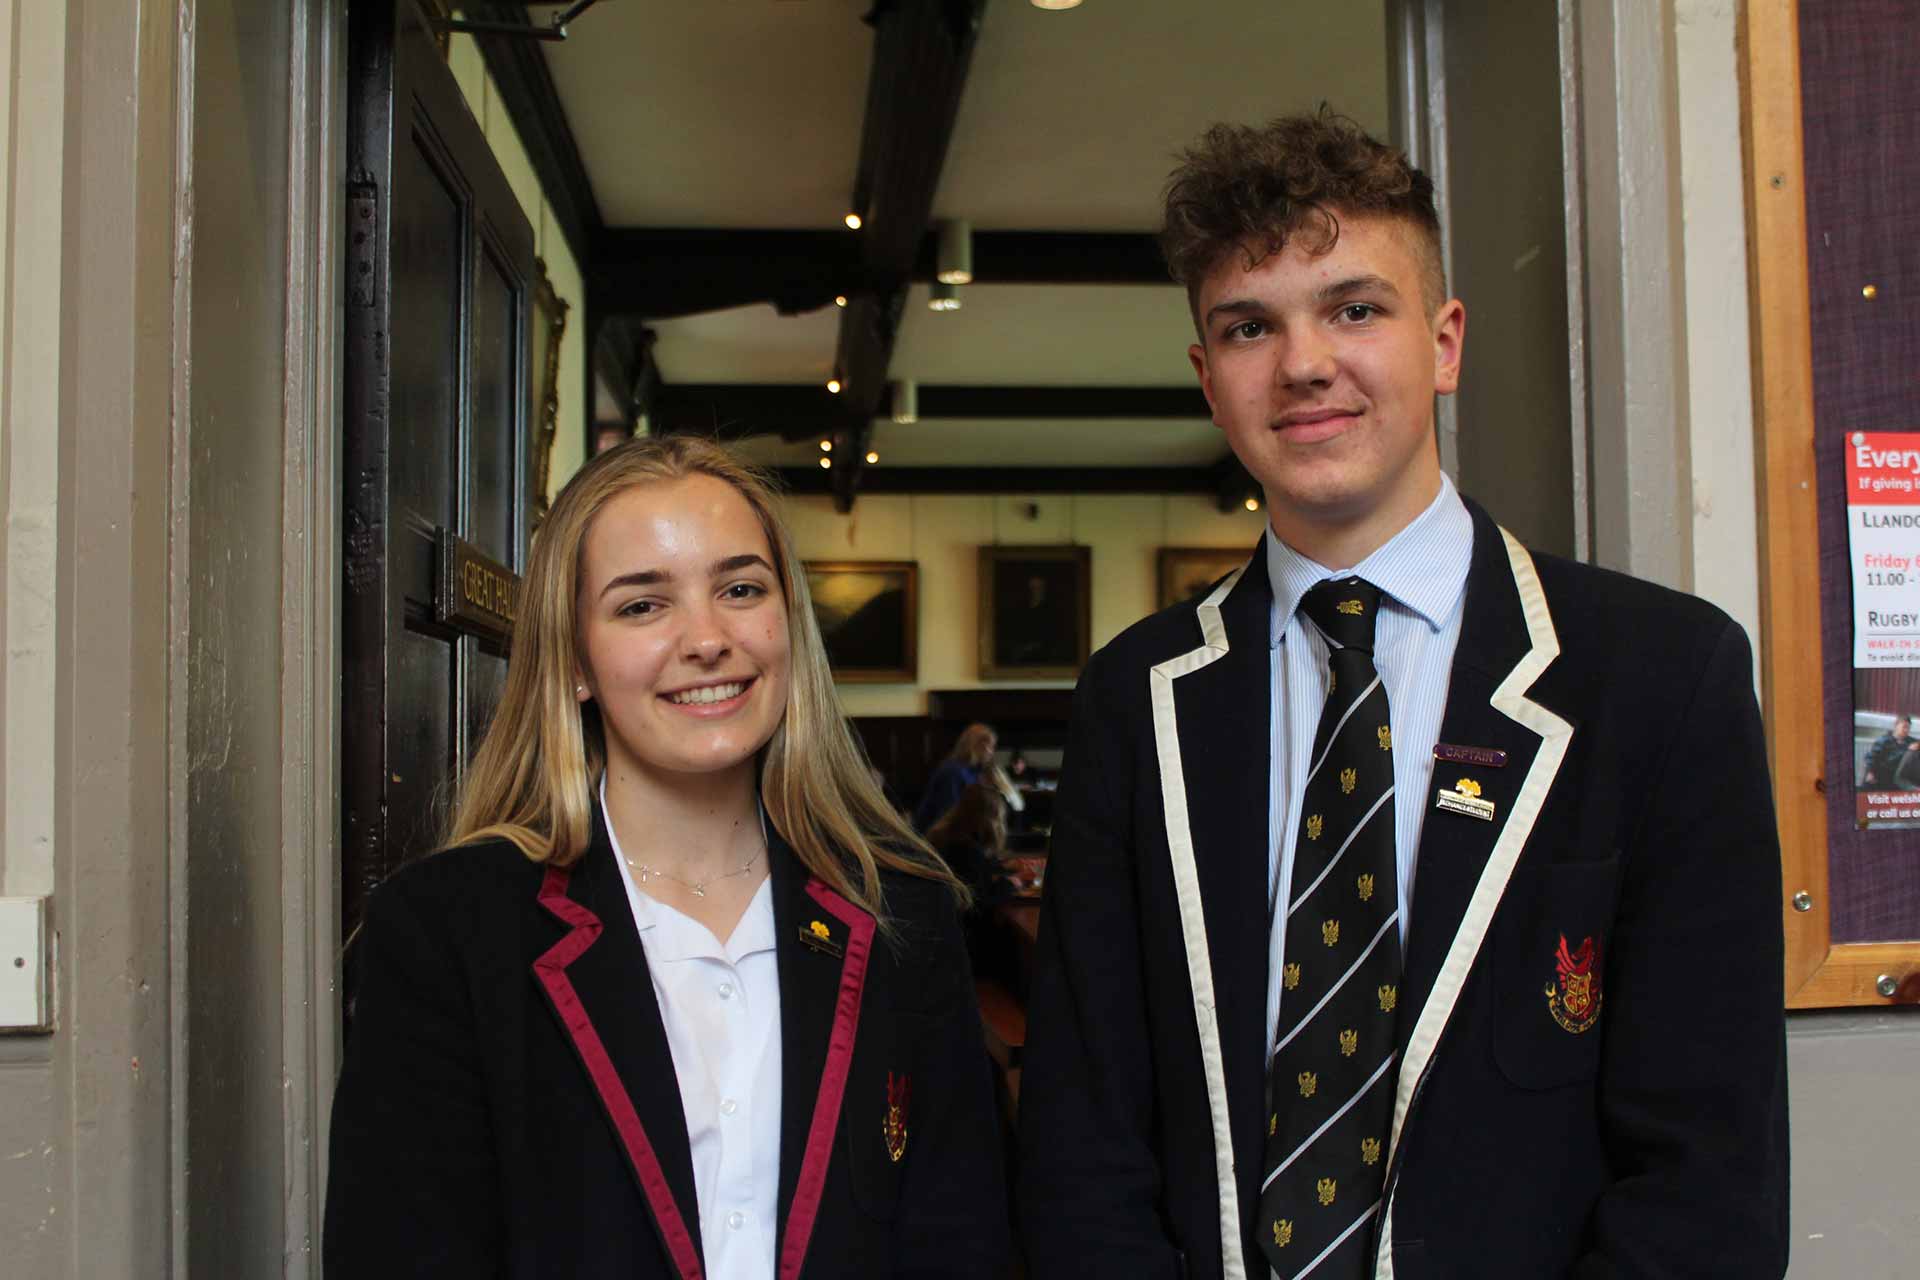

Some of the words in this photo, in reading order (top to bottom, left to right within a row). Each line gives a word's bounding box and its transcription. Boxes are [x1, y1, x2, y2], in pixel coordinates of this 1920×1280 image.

[1859, 477, 1870, 489] If
[1872, 477, 1912, 493] giving
[1864, 554, 1910, 571] Friday
[1867, 573, 1905, 586] 11.00
[496, 575, 515, 620] HAL
[1868, 611, 1918, 627] RUGBY
[1446, 747, 1495, 763] CAPTAIN
